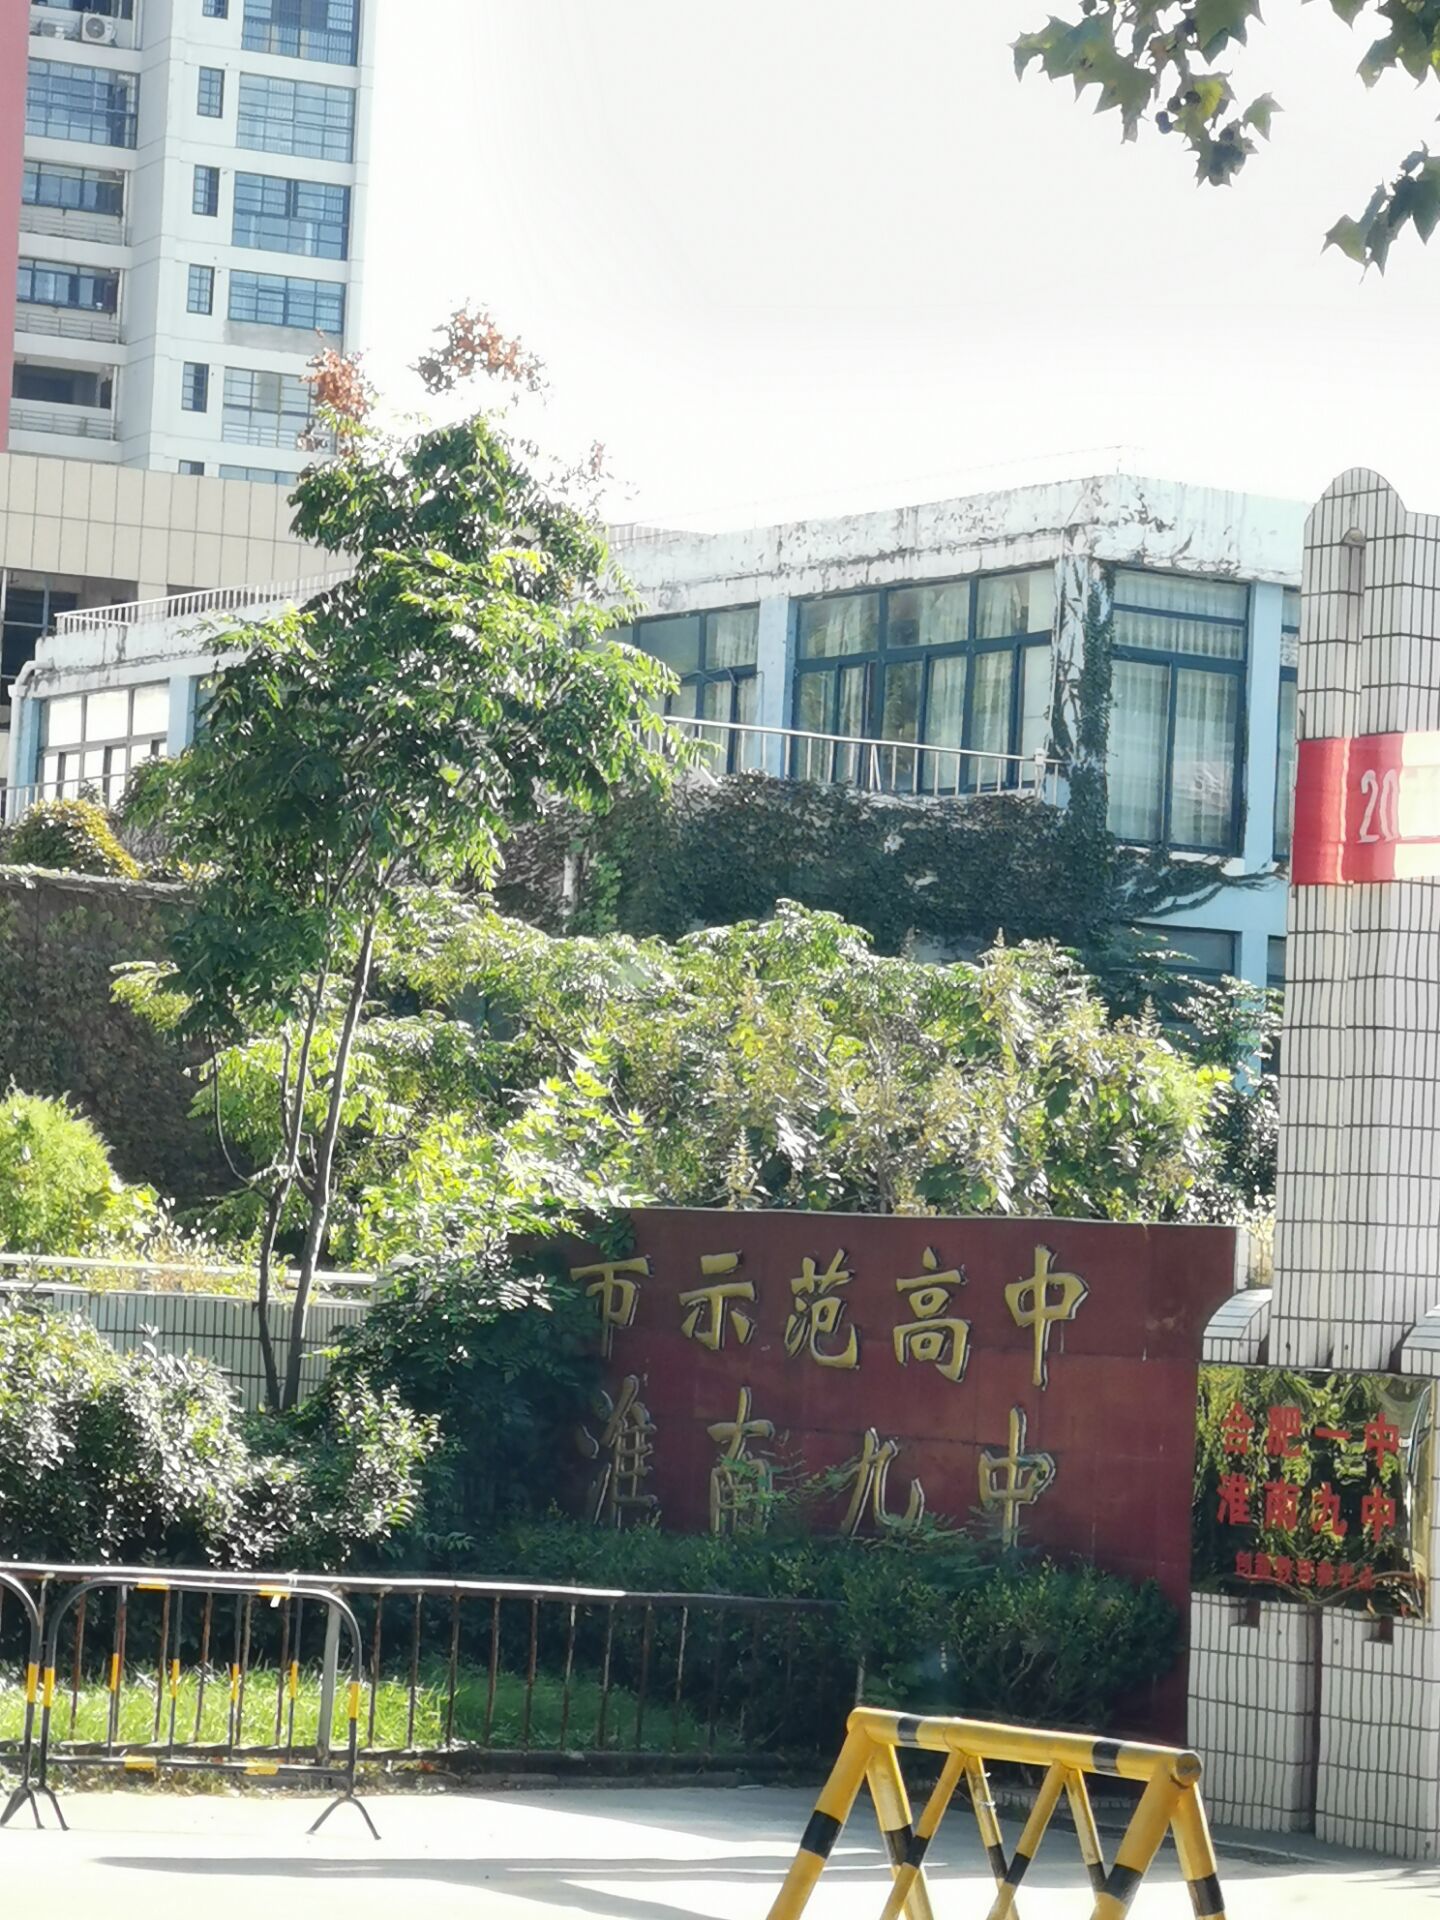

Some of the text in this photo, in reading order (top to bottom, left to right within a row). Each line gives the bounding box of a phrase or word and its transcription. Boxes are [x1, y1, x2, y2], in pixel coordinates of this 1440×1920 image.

[570, 1243, 1090, 1390] 市示范高中
[577, 1374, 1057, 1551] 淮南九中
[1221, 1401, 1400, 1469] 合肥一中
[1216, 1472, 1397, 1543] 淮南九中
